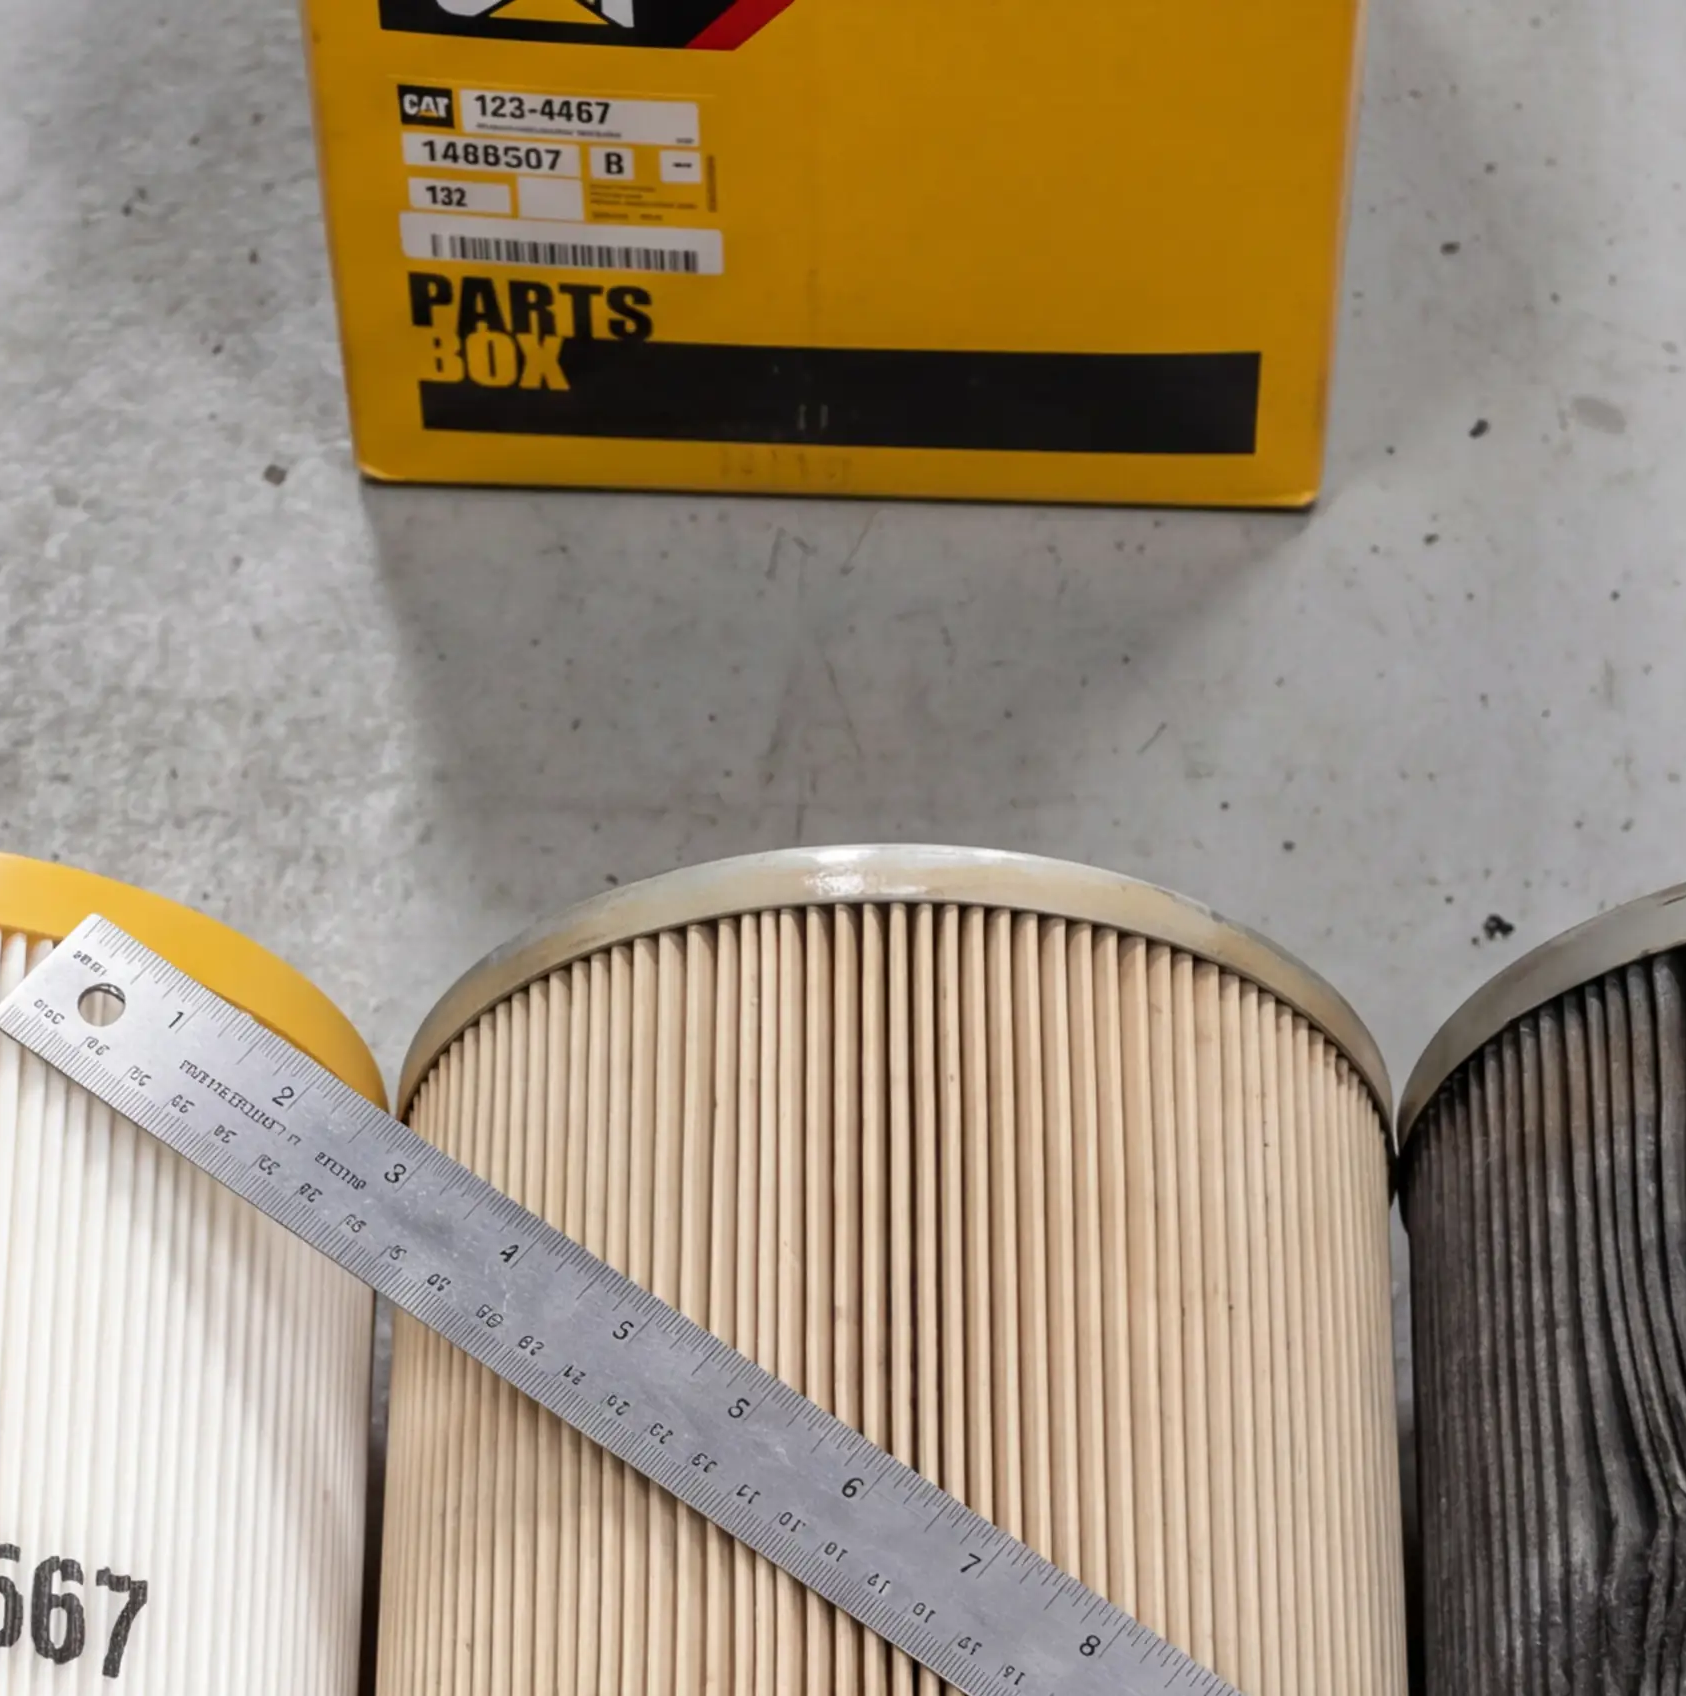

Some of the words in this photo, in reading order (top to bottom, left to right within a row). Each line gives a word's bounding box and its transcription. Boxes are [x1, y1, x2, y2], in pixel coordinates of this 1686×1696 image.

[403, 93, 449, 118] CAT
[474, 94, 611, 125] 123-4467
[604, 152, 625, 176] B
[425, 185, 468, 208] 132
[407, 271, 654, 342] PARTS
[419, 325, 571, 392] BOX
[270, 1085, 296, 1108] 2
[382, 1162, 408, 1185] 3
[840, 1476, 866, 1500] 6
[959, 1551, 983, 1574] 7
[1078, 1633, 1102, 1658] 8
